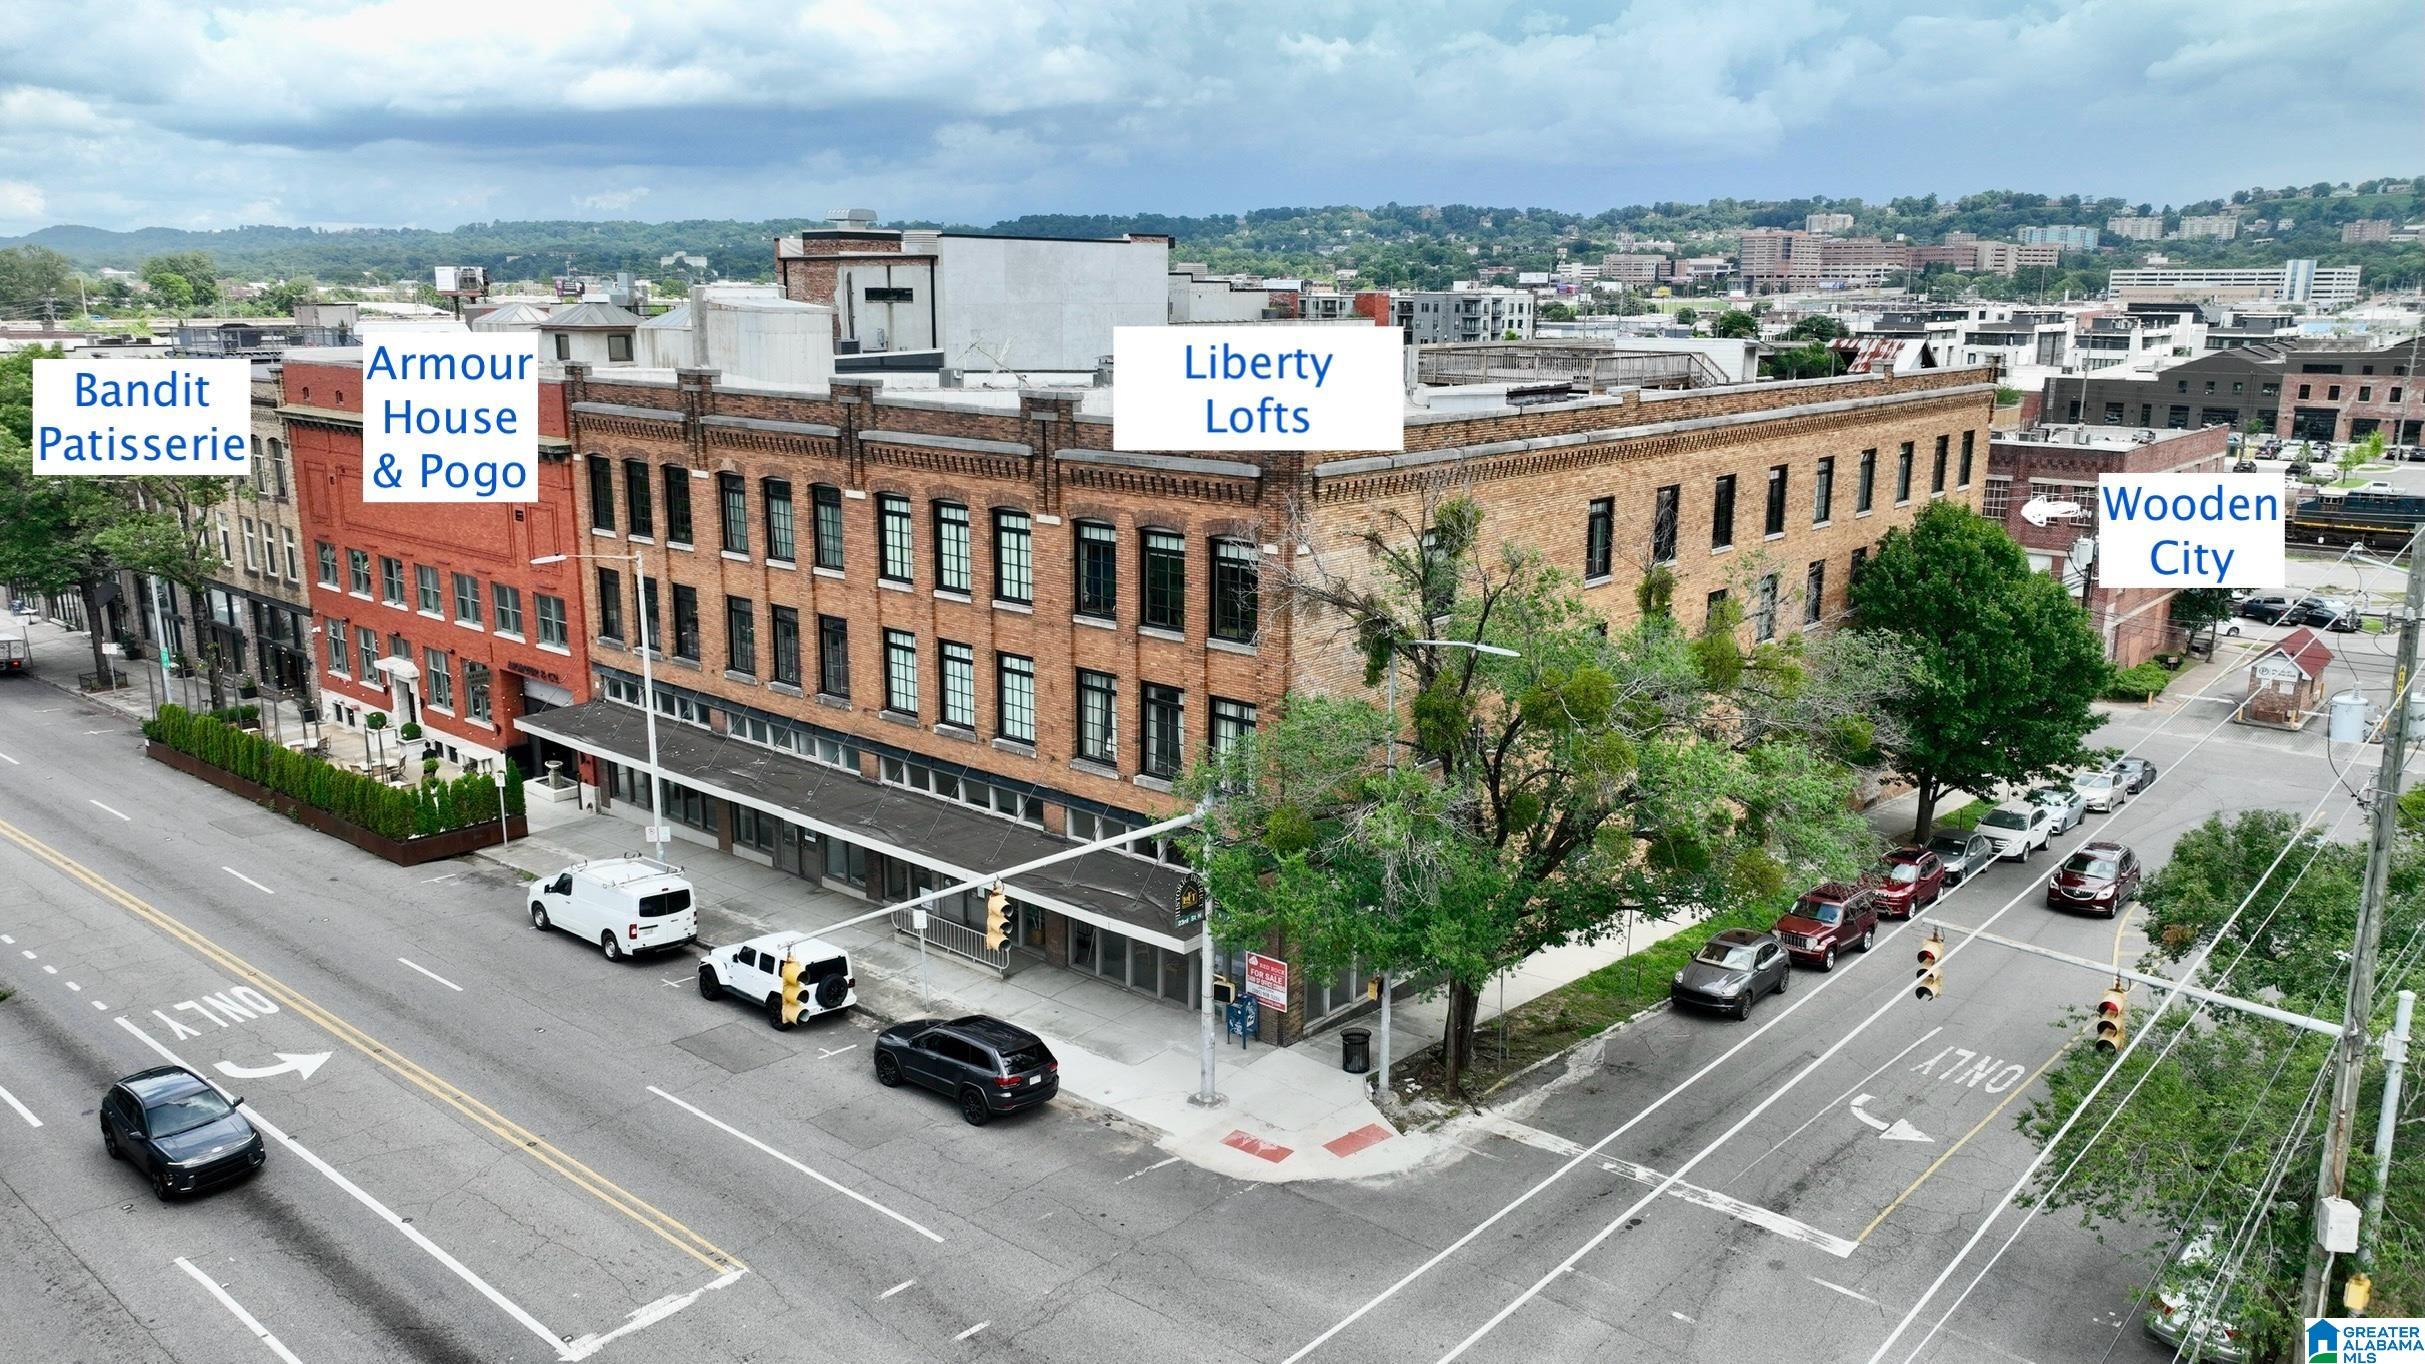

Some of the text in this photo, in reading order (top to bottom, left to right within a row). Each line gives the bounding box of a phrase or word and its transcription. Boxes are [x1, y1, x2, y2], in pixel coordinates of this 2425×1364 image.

[1175, 874, 1188, 920] HISTORIC
[1177, 917, 1189, 927] 23rd
[1250, 968, 1264, 979] FOR
[1265, 973, 1283, 985] SALE
[152, 985, 280, 1041] ONLY
[1909, 1045, 2026, 1094] ONLY
